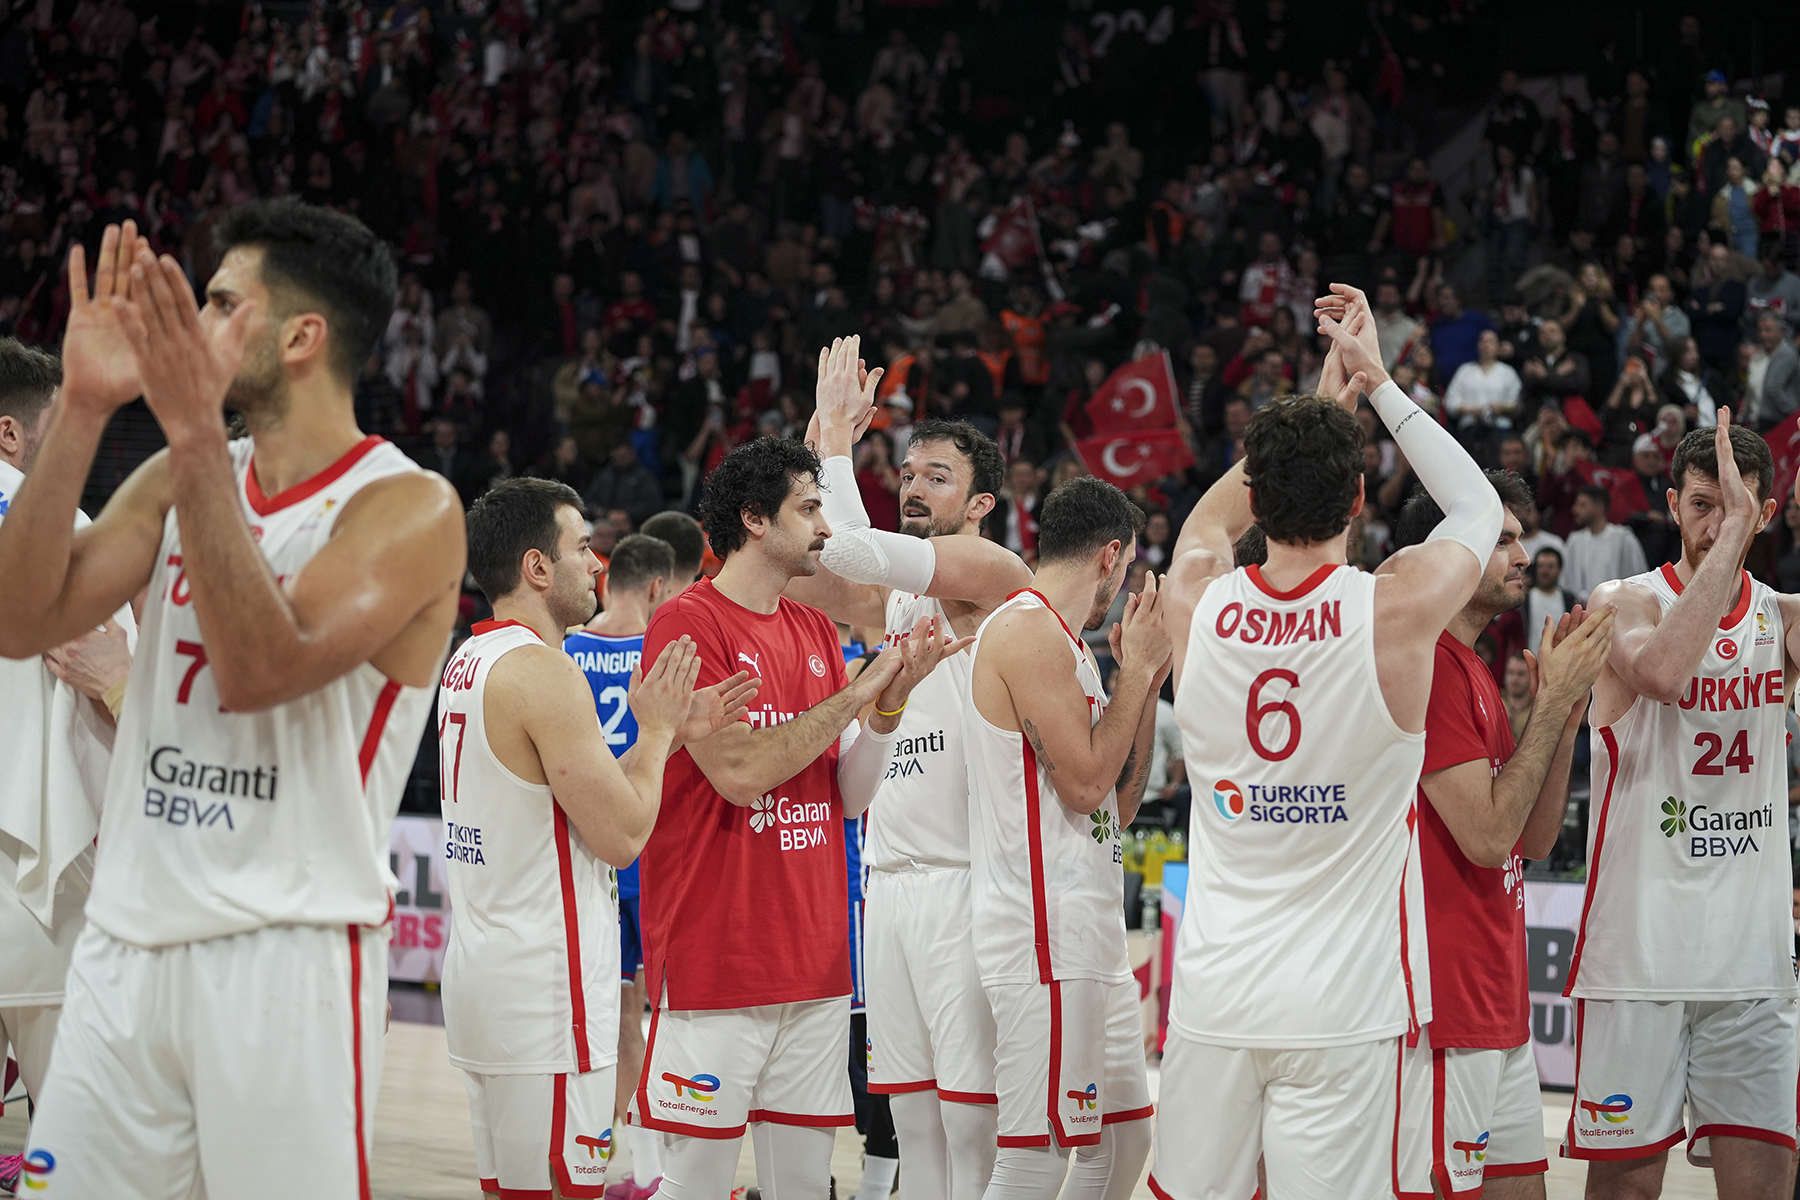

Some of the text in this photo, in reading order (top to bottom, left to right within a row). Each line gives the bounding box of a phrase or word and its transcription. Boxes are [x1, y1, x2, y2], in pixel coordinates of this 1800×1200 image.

[1215, 600, 1342, 646] OSMAN
[600, 685, 628, 745] 2
[1246, 667, 1302, 762] 6
[439, 709, 466, 804] 17
[893, 730, 945, 757] aranti
[1691, 729, 1755, 776] 24
[149, 745, 279, 801] Garanti
[884, 757, 924, 779] BVA
[144, 788, 235, 832] BBVA
[777, 797, 831, 824] Garan
[1689, 803, 1773, 832] Garanti
[780, 825, 828, 851] BBVA
[1690, 834, 1760, 858] BBVA
[389, 915, 444, 949] RS
[658, 1100, 718, 1116] TotalEnergies
[1579, 1127, 1635, 1138] TotalEnergies
